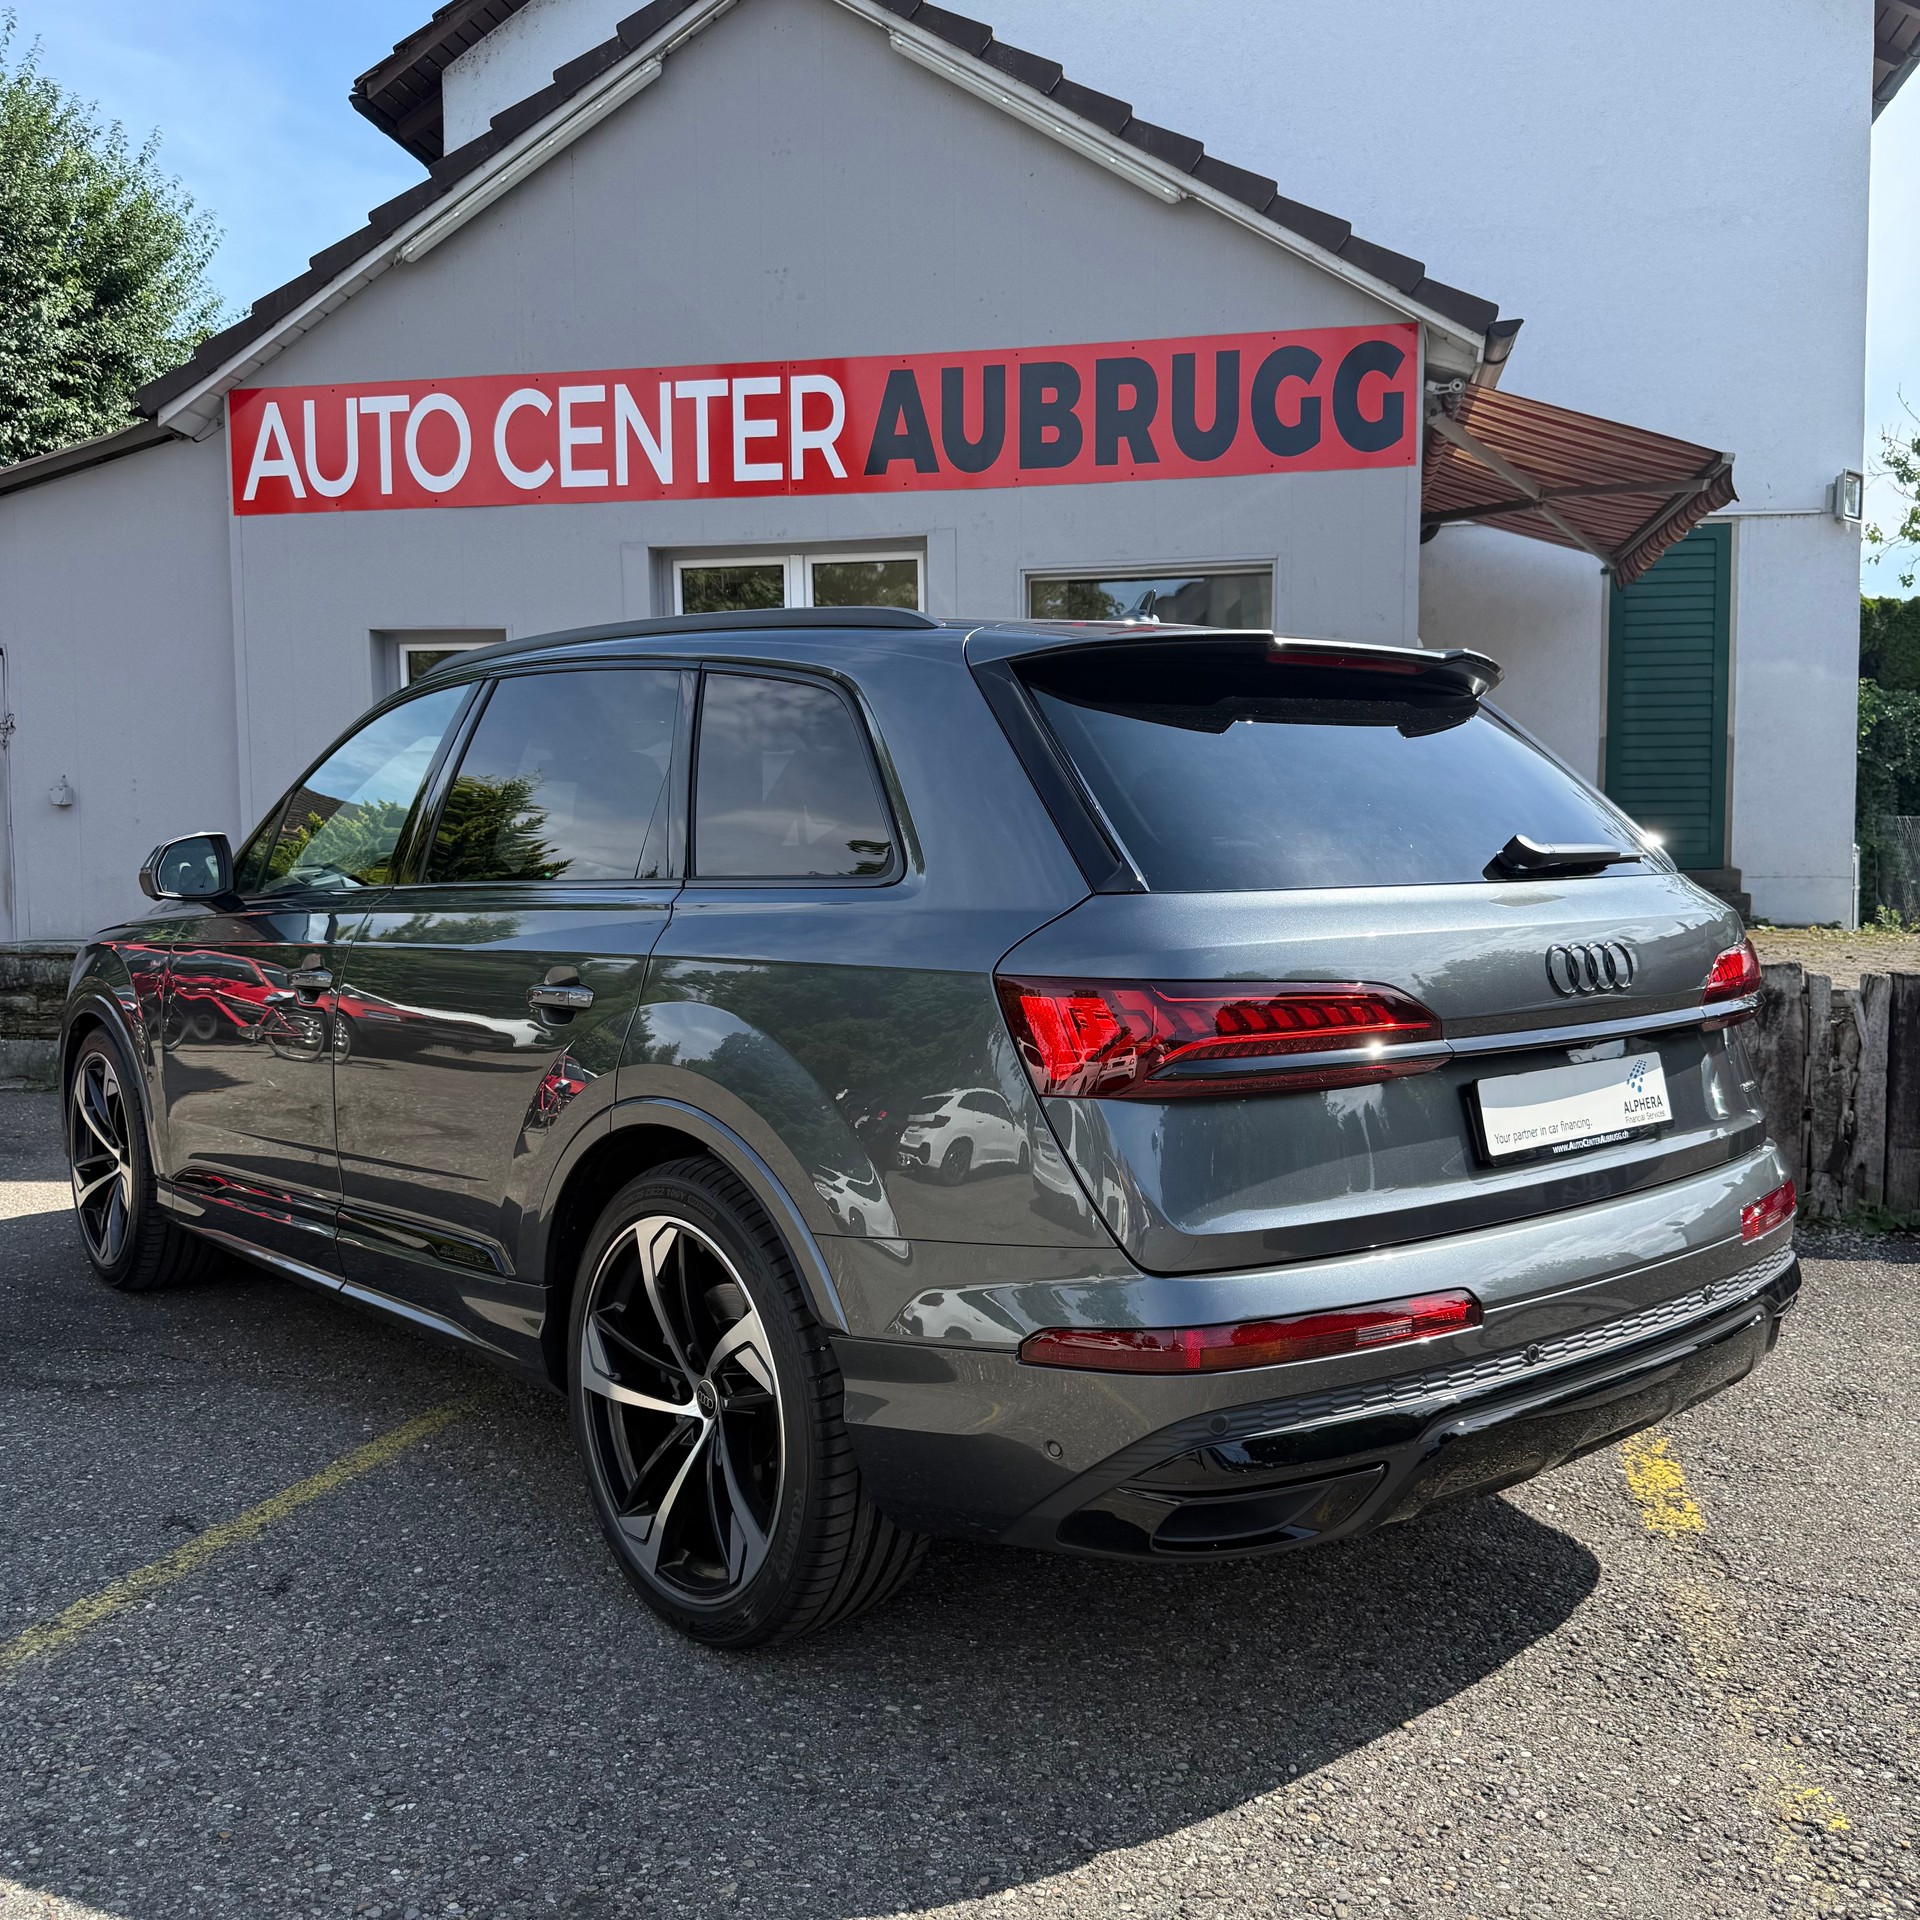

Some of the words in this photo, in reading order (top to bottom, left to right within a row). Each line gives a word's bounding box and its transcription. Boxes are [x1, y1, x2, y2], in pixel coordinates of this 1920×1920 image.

[243, 392, 472, 501] AUTO
[493, 374, 848, 491] CENTER
[863, 340, 1406, 476] AUBRUGG
[1624, 1095, 1664, 1114] ALPHERA
[1625, 1113, 1646, 1125] Financial
[1646, 1110, 1666, 1120] Services
[1494, 1133, 1511, 1144] Your
[1512, 1127, 1538, 1144] partner
[1539, 1125, 1547, 1136] in
[1548, 1123, 1559, 1134] car
[1560, 1117, 1593, 1131] financing.
